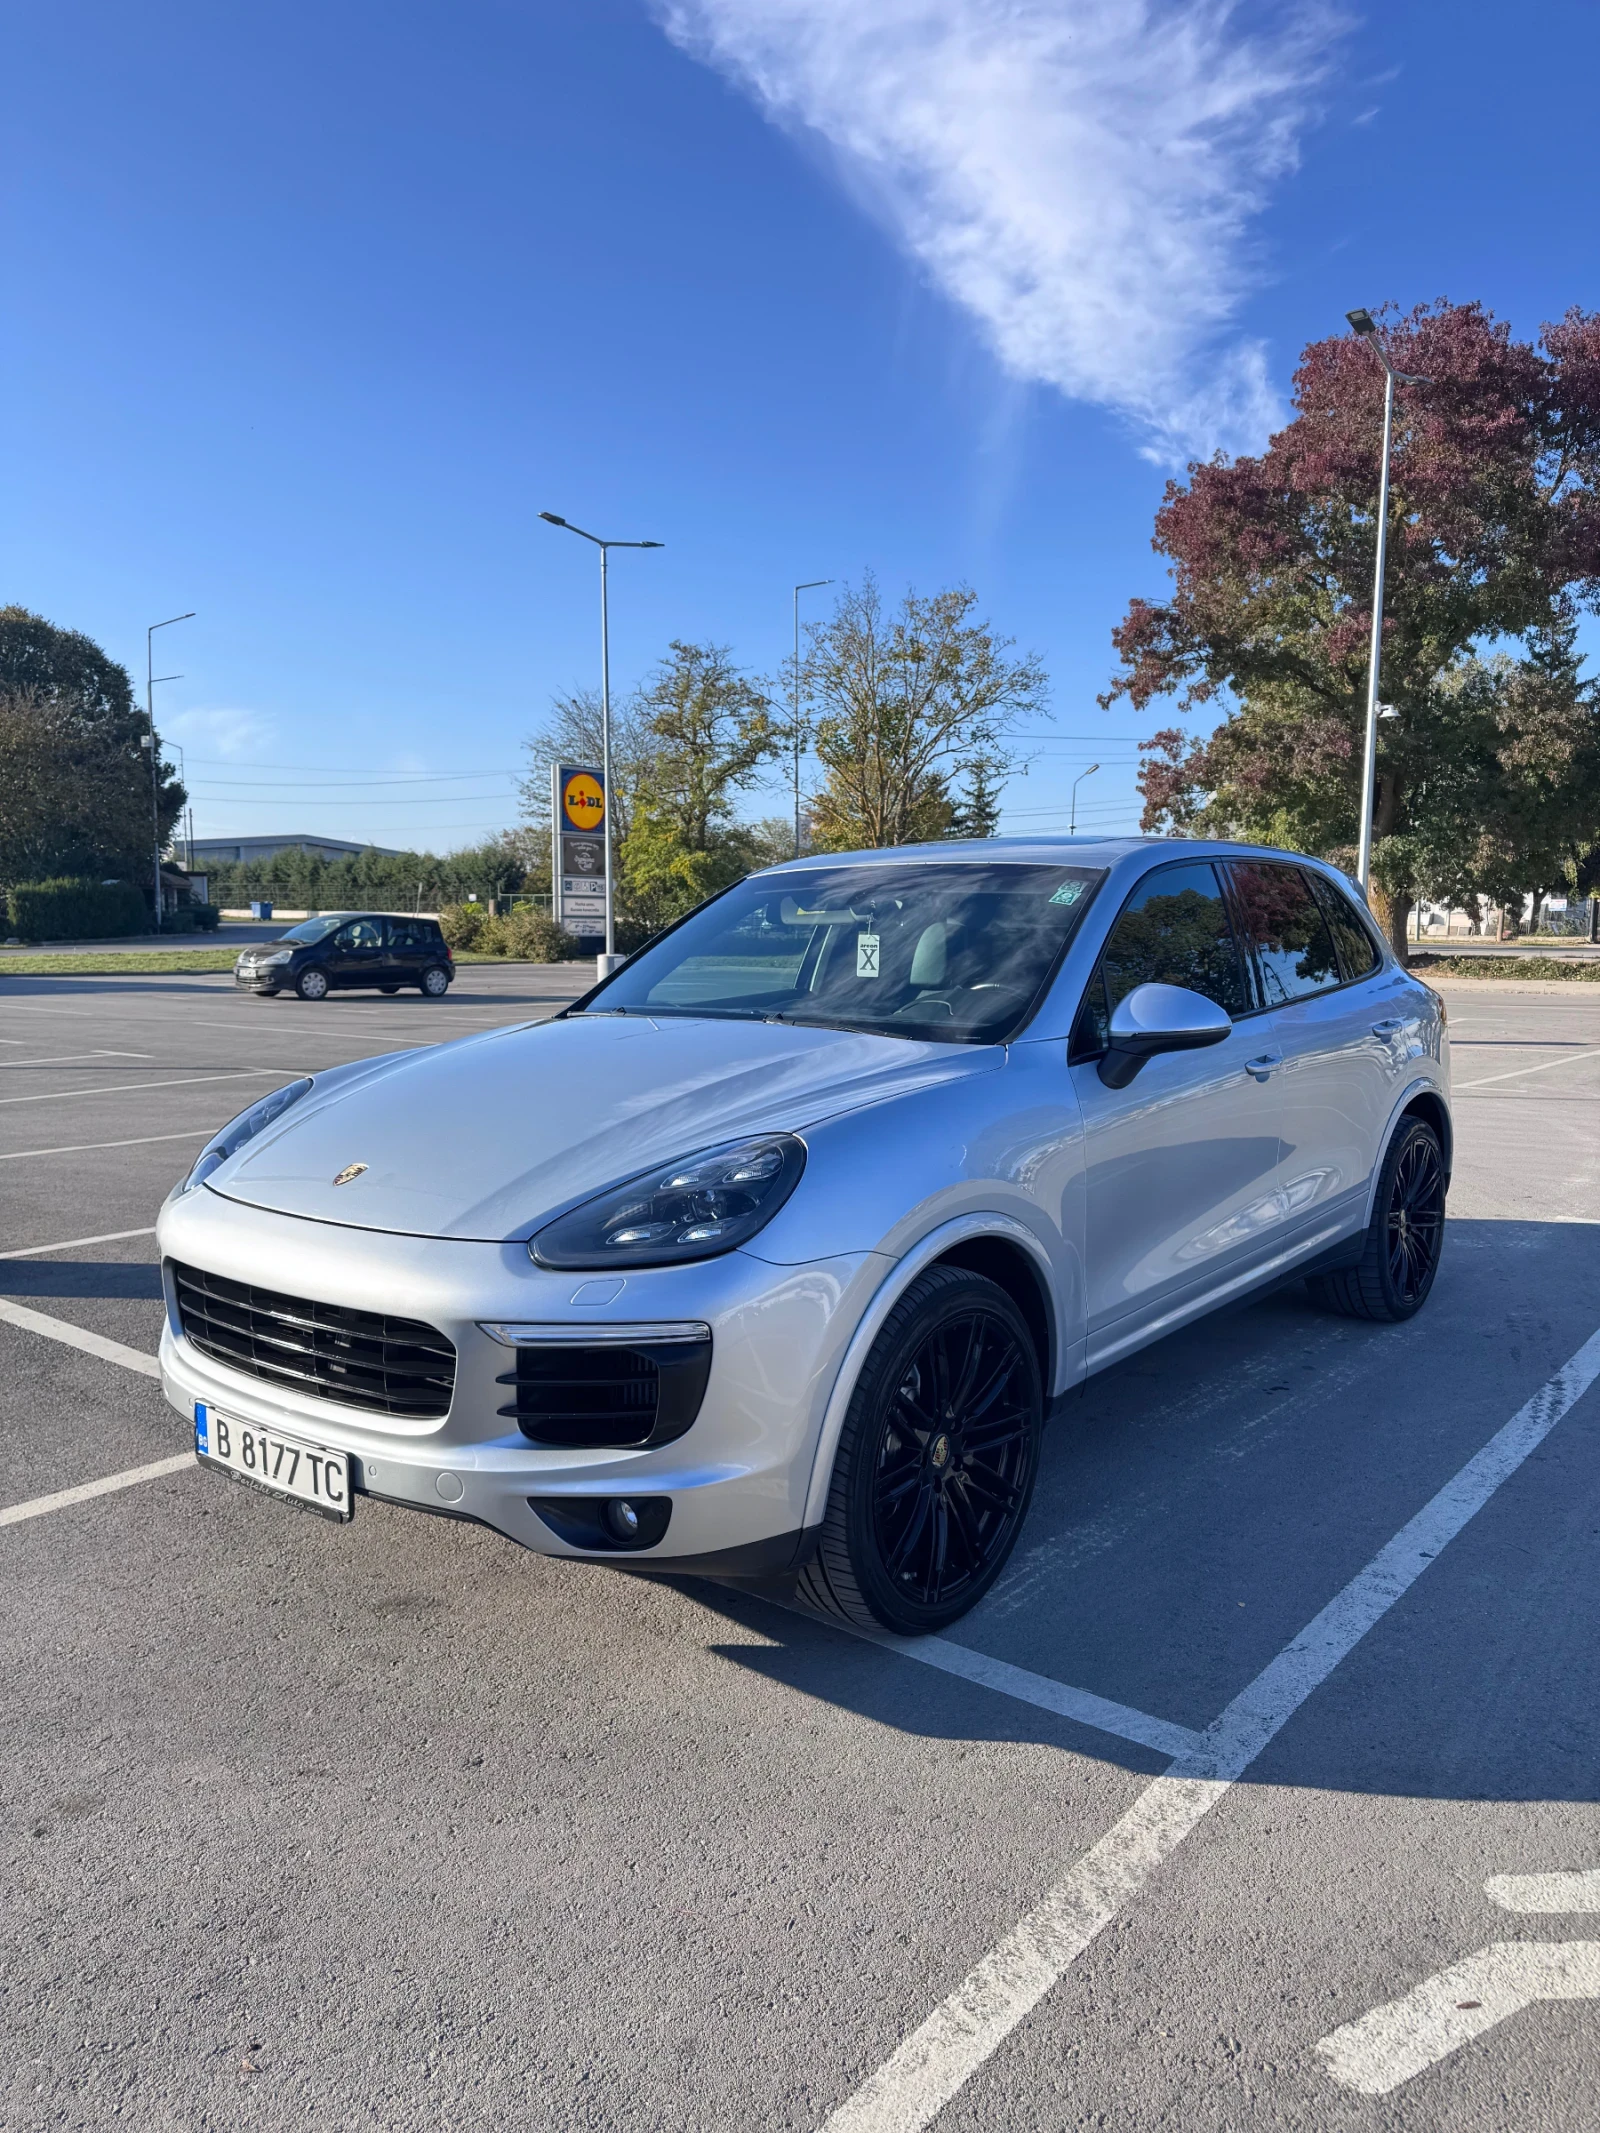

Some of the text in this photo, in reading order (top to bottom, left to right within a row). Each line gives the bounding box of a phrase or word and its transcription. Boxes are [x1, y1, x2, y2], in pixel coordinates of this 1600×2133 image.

[860, 949, 877, 971] X
[198, 1433, 208, 1448] BG
[216, 1418, 343, 1502] B 8177 TC
